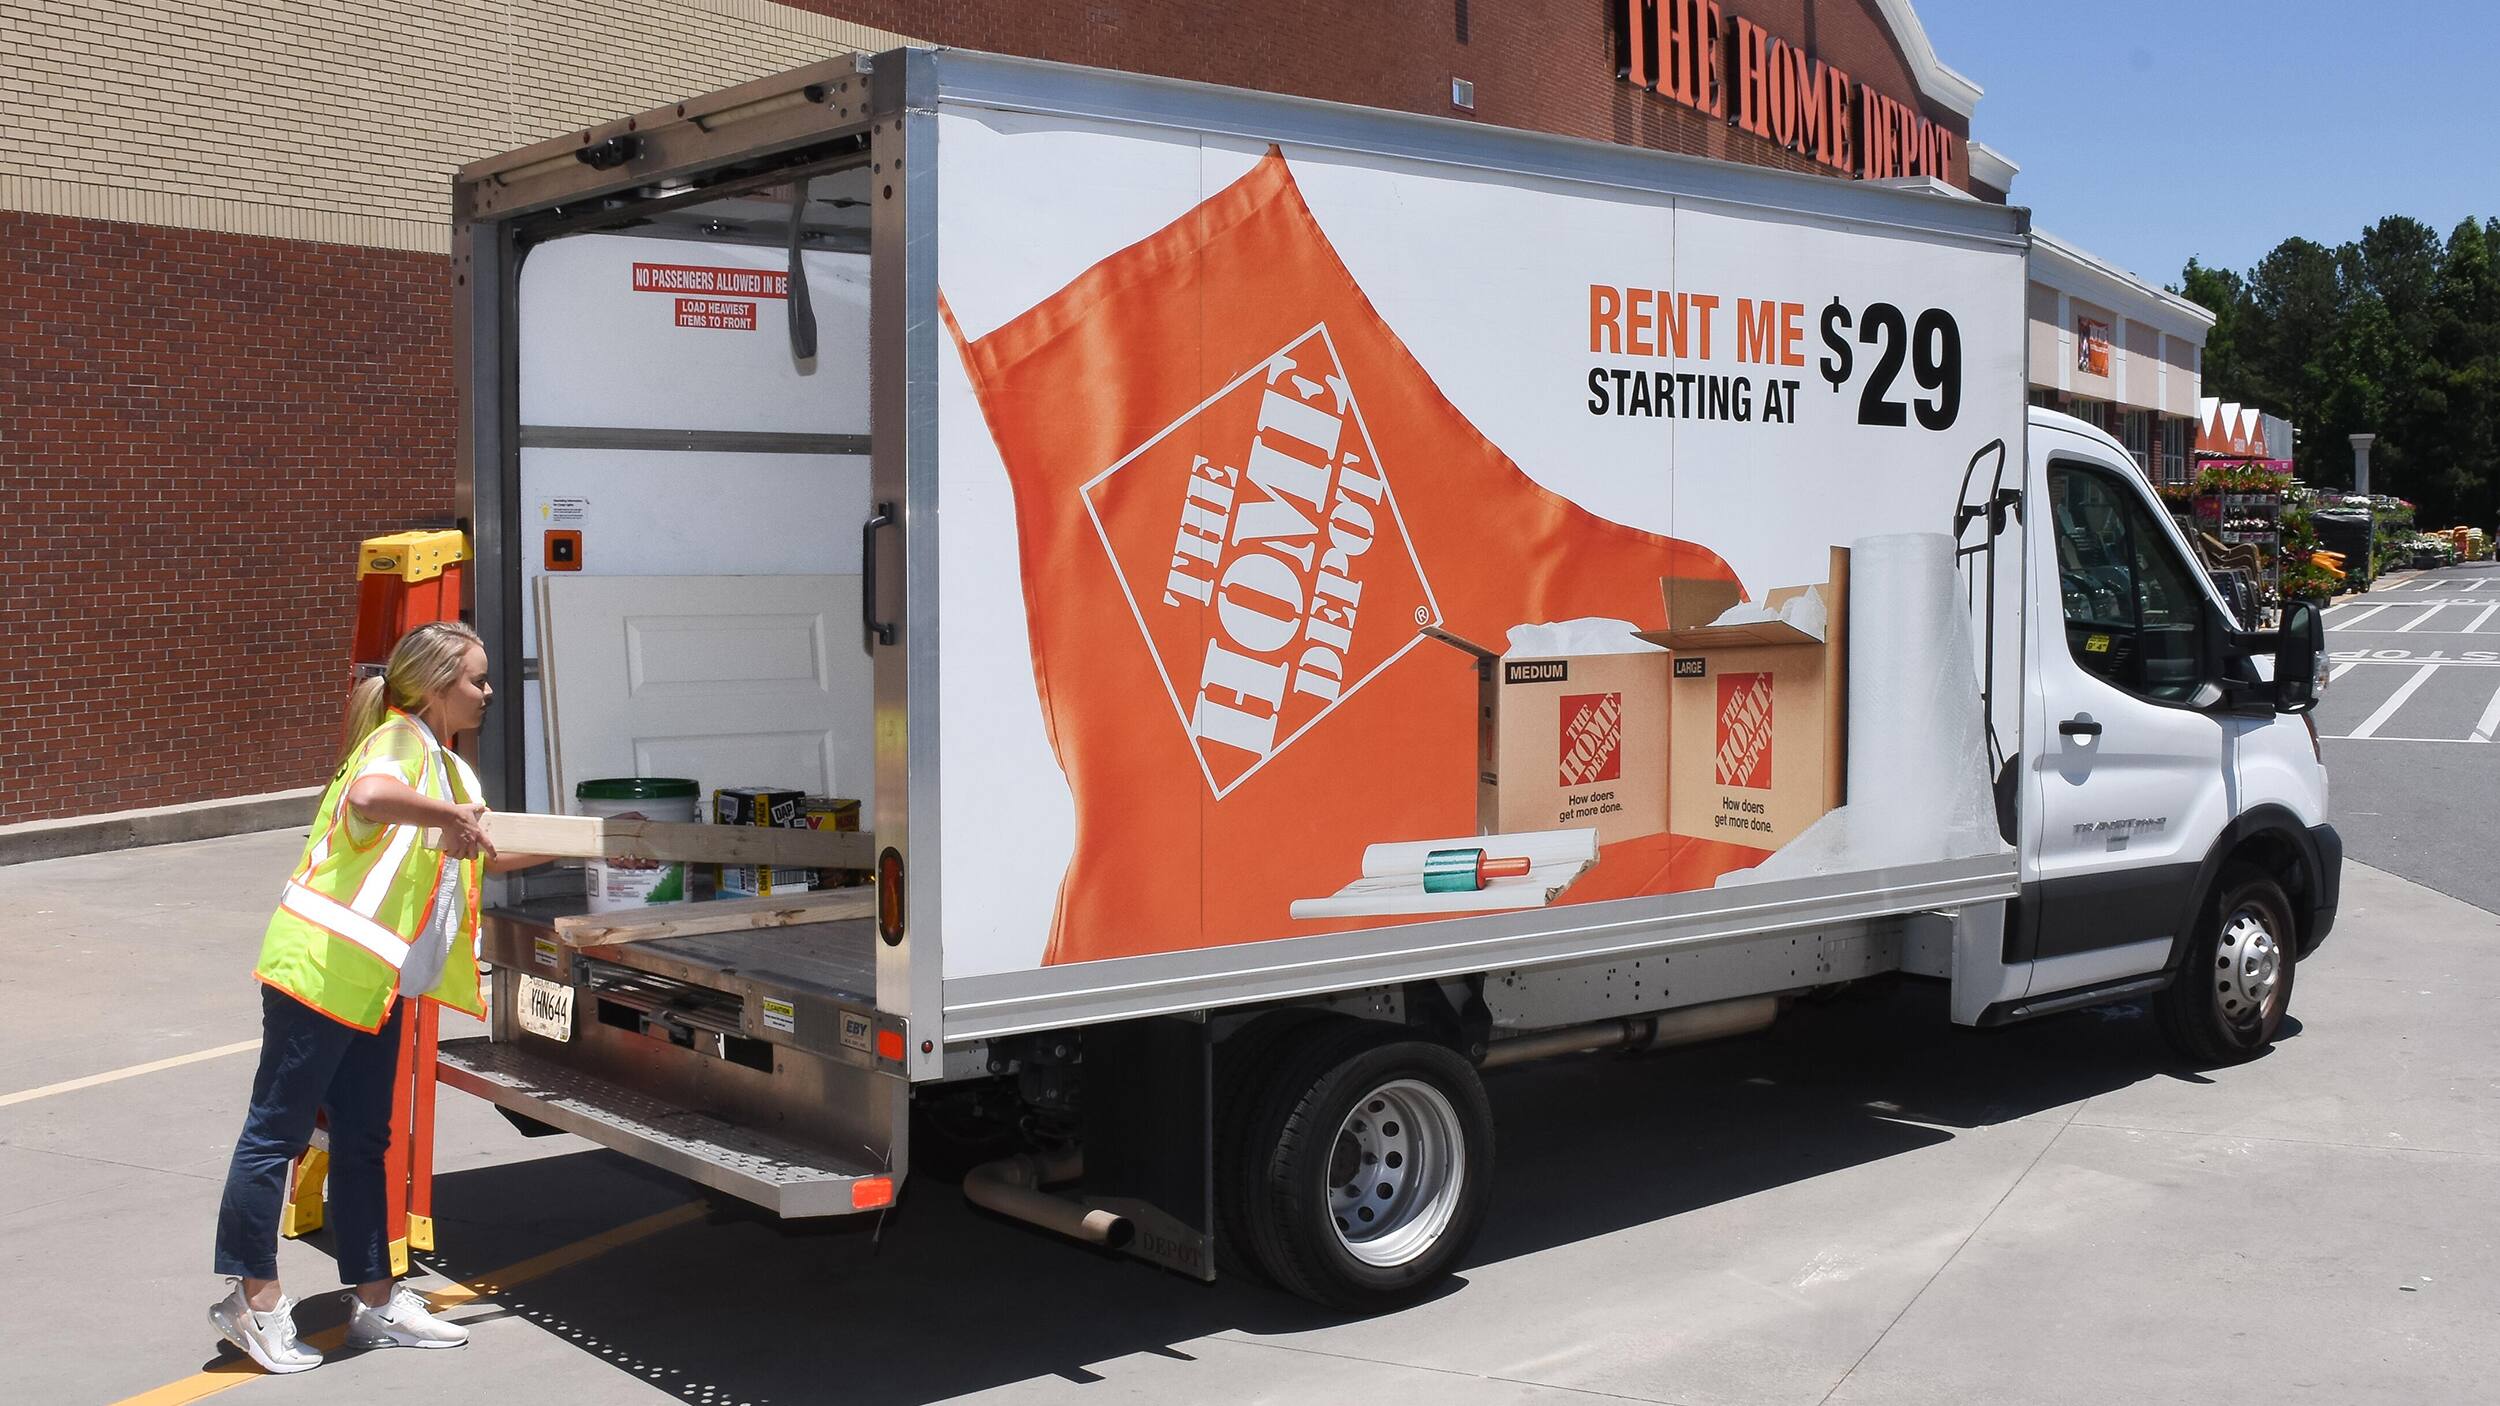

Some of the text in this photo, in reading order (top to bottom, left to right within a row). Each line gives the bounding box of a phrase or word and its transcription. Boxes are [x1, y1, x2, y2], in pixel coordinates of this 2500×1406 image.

[1627, 0, 1953, 183] THE HOME DEPOT
[636, 268, 788, 295] NO PASSENGERS ALLOWED IN BE
[679, 314, 752, 329] ITEMS TO FRONT
[682, 301, 749, 316] LOAD HEAVIEST
[1589, 284, 1805, 367] RENT ME
[1819, 296, 1963, 431] $29
[1588, 367, 1801, 424] STARTING AT
[1163, 454, 1239, 607] THE
[1188, 355, 1349, 760] HOME
[1293, 451, 1385, 703] DEPOT
[1510, 664, 1563, 680] MEDIUM
[1676, 661, 1703, 674] LARGE
[1566, 704, 1592, 741] THE
[1721, 685, 1746, 730] THE
[1559, 693, 1622, 786] HOME
[1715, 672, 1774, 785] HOME
[1584, 724, 1621, 783] DEPOT
[1737, 715, 1773, 787] DEPOT
[774, 802, 793, 822] DAP
[1559, 801, 1624, 823] get more done.
[1568, 790, 1615, 806] How doers
[1722, 796, 1765, 815] How doers
[1714, 813, 1774, 833] get more done.
[531, 987, 568, 1026] YHN644
[846, 1019, 868, 1037] EBY
